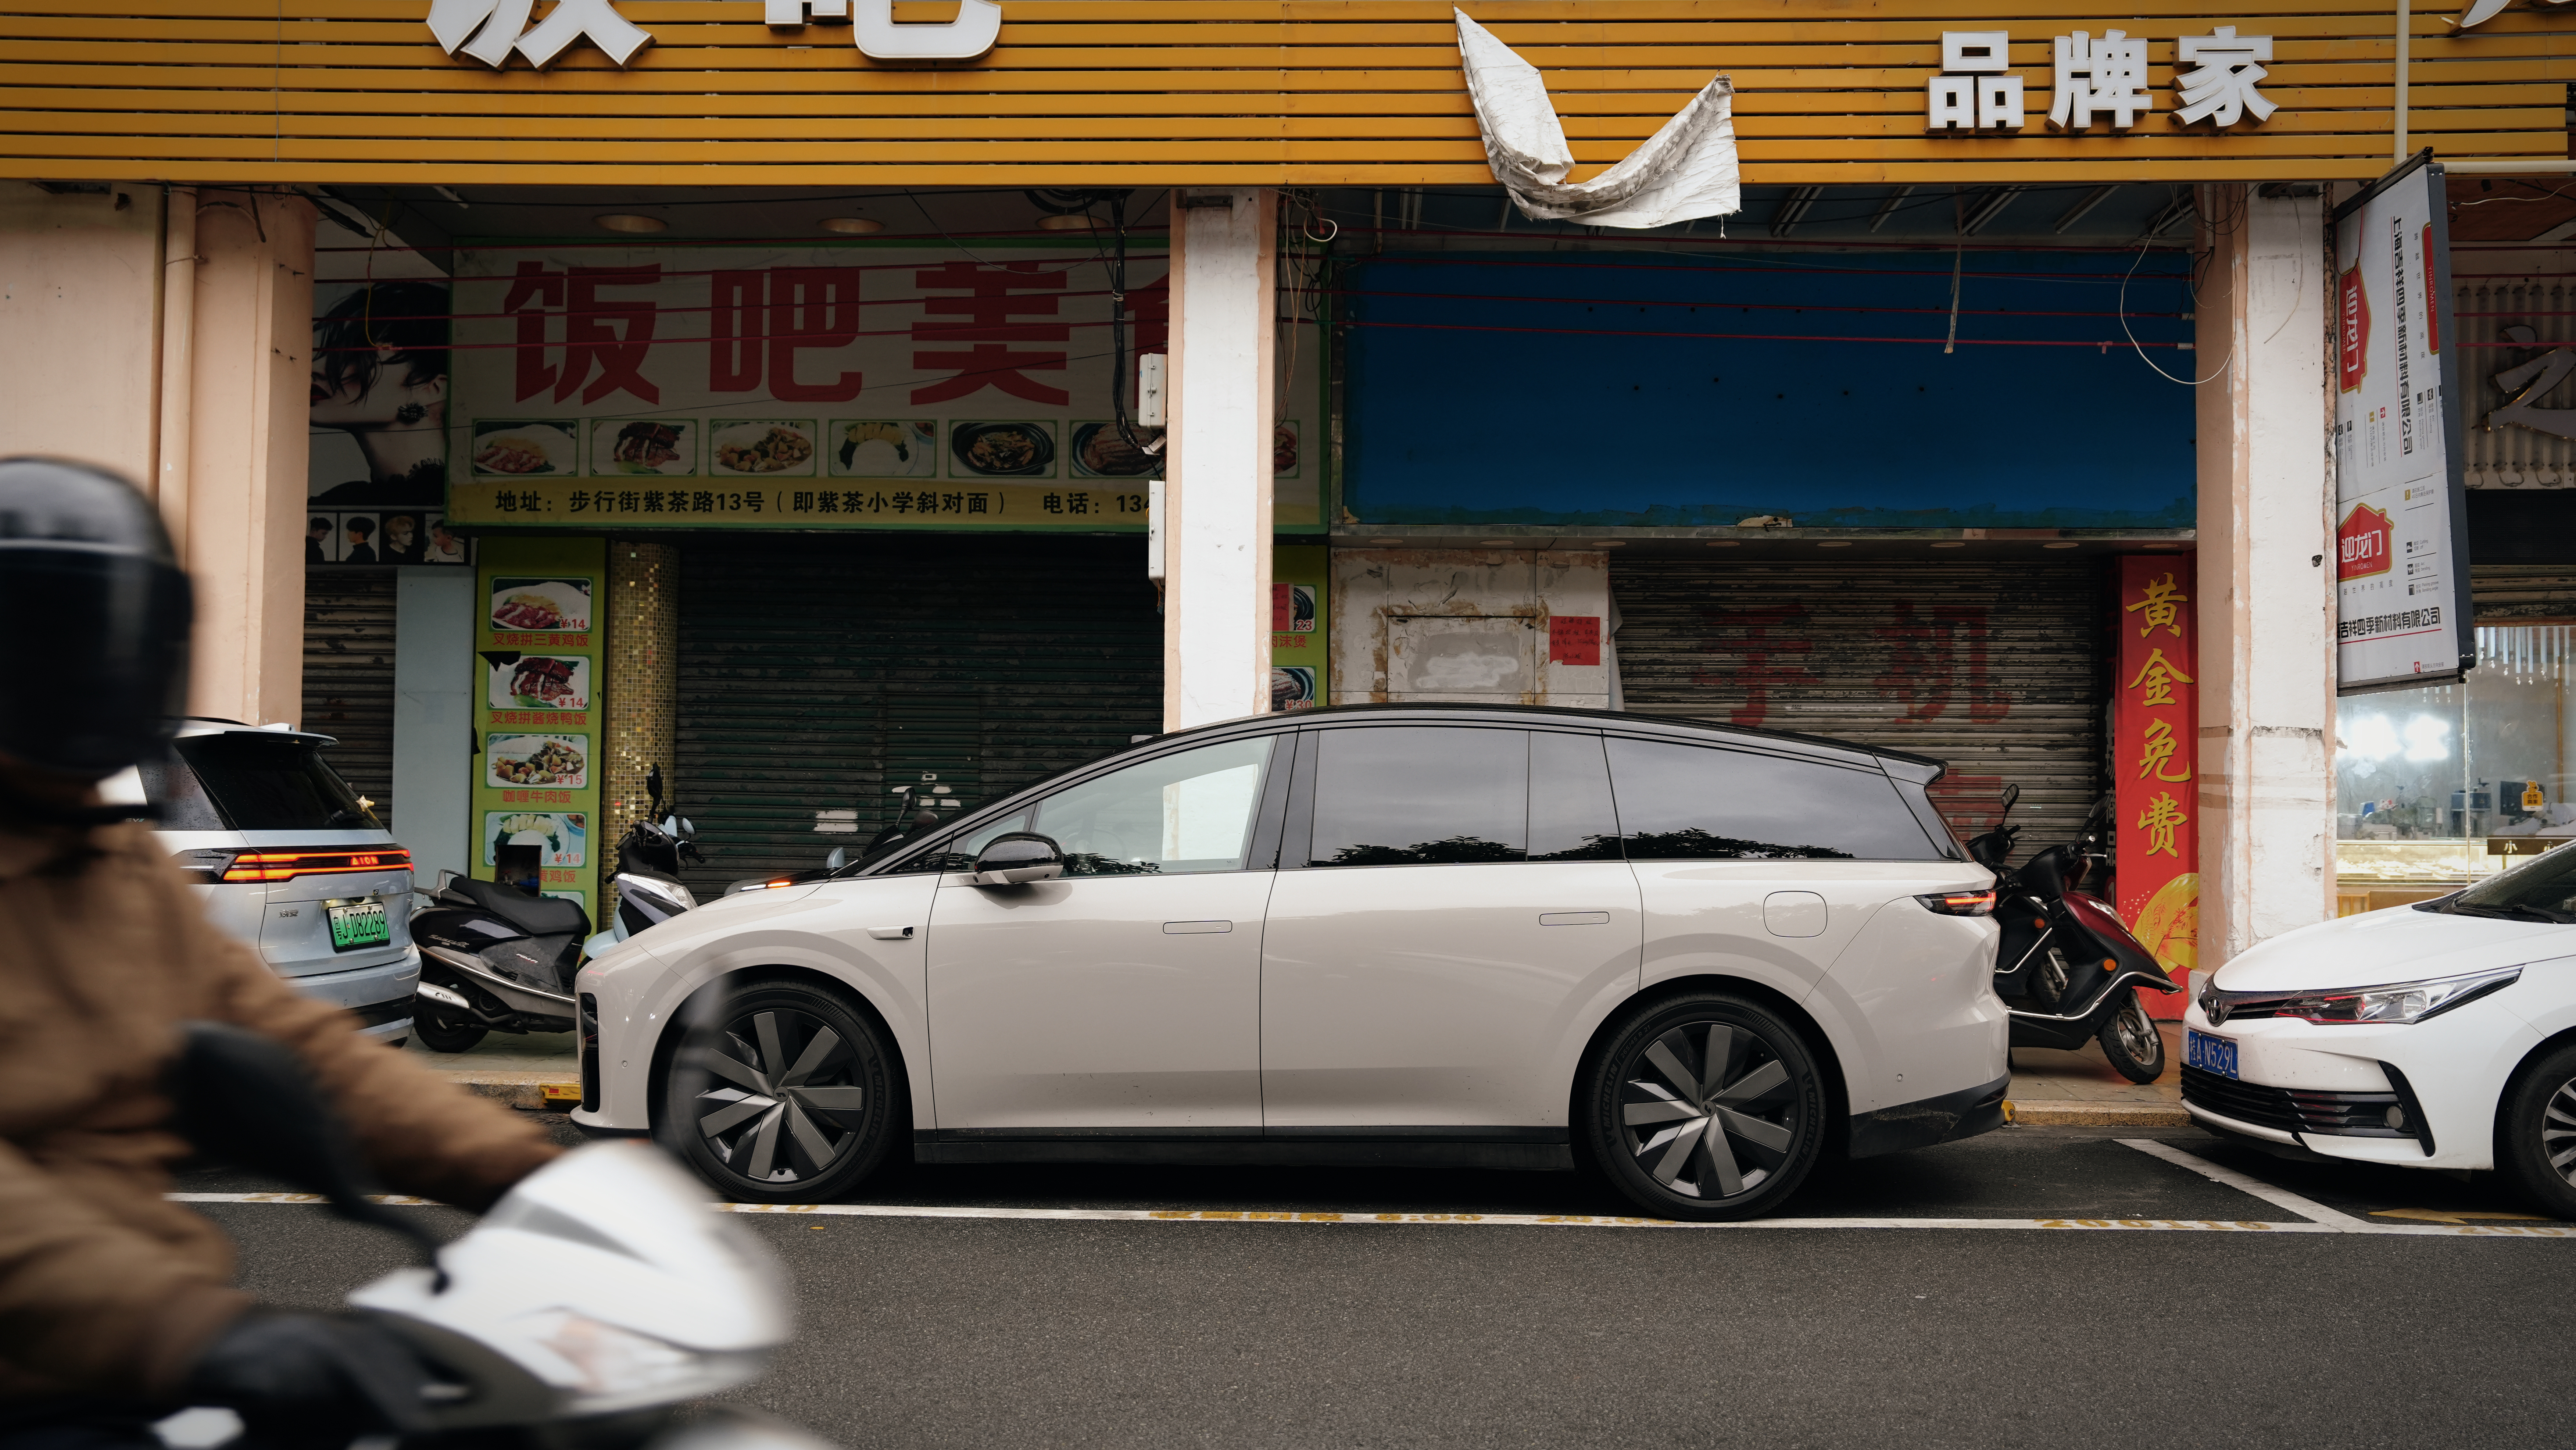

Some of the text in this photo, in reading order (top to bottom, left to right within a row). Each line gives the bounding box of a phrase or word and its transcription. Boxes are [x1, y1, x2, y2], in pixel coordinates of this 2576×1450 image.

[1926, 26, 2279, 132] 品牌家
[2427, 265, 2435, 312] YINROMEN
[2346, 285, 2358, 372] 迎龙门
[2393, 215, 2412, 456] 上海吉祥四季新材料有限公司
[2341, 530, 2382, 563] 迎龙门
[2351, 561, 2373, 572] YINROMEN
[493, 633, 589, 647] 叉烧拼三黄鸡饭
[491, 711, 587, 725] 叉烧拼酱烧鸭饭
[2125, 572, 2194, 858] 黄金免费
[502, 789, 571, 804] 咖喱牛肉饭
[1644, 1024, 1652, 1032] 21
[869, 1075, 884, 1138] MICHELIN
[1603, 1064, 1619, 1129] MICHELIN
[1802, 1091, 1817, 1157] MICHELIN
[2034, 1219, 2271, 1230] 200110
[2444, 1225, 2576, 1236] 200
